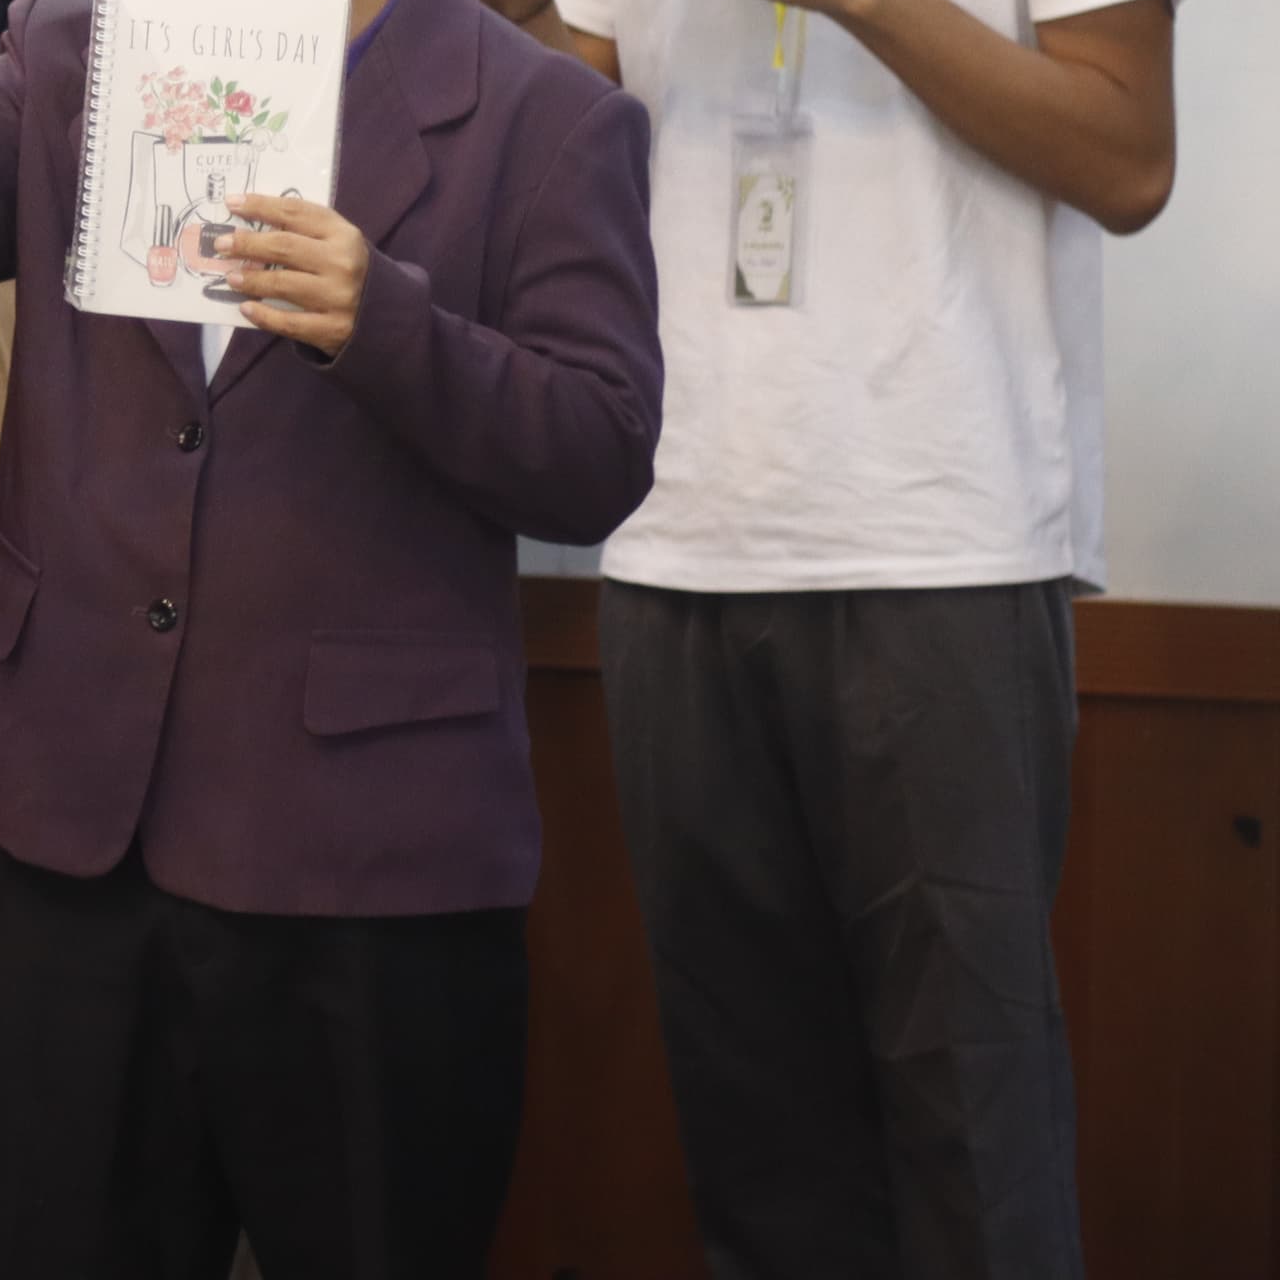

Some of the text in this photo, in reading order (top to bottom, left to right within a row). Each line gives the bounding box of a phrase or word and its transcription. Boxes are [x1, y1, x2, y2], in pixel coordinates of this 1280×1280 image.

[128, 17, 320, 65] IT'S GIRL'S DAY
[196, 154, 233, 167] CUTE
